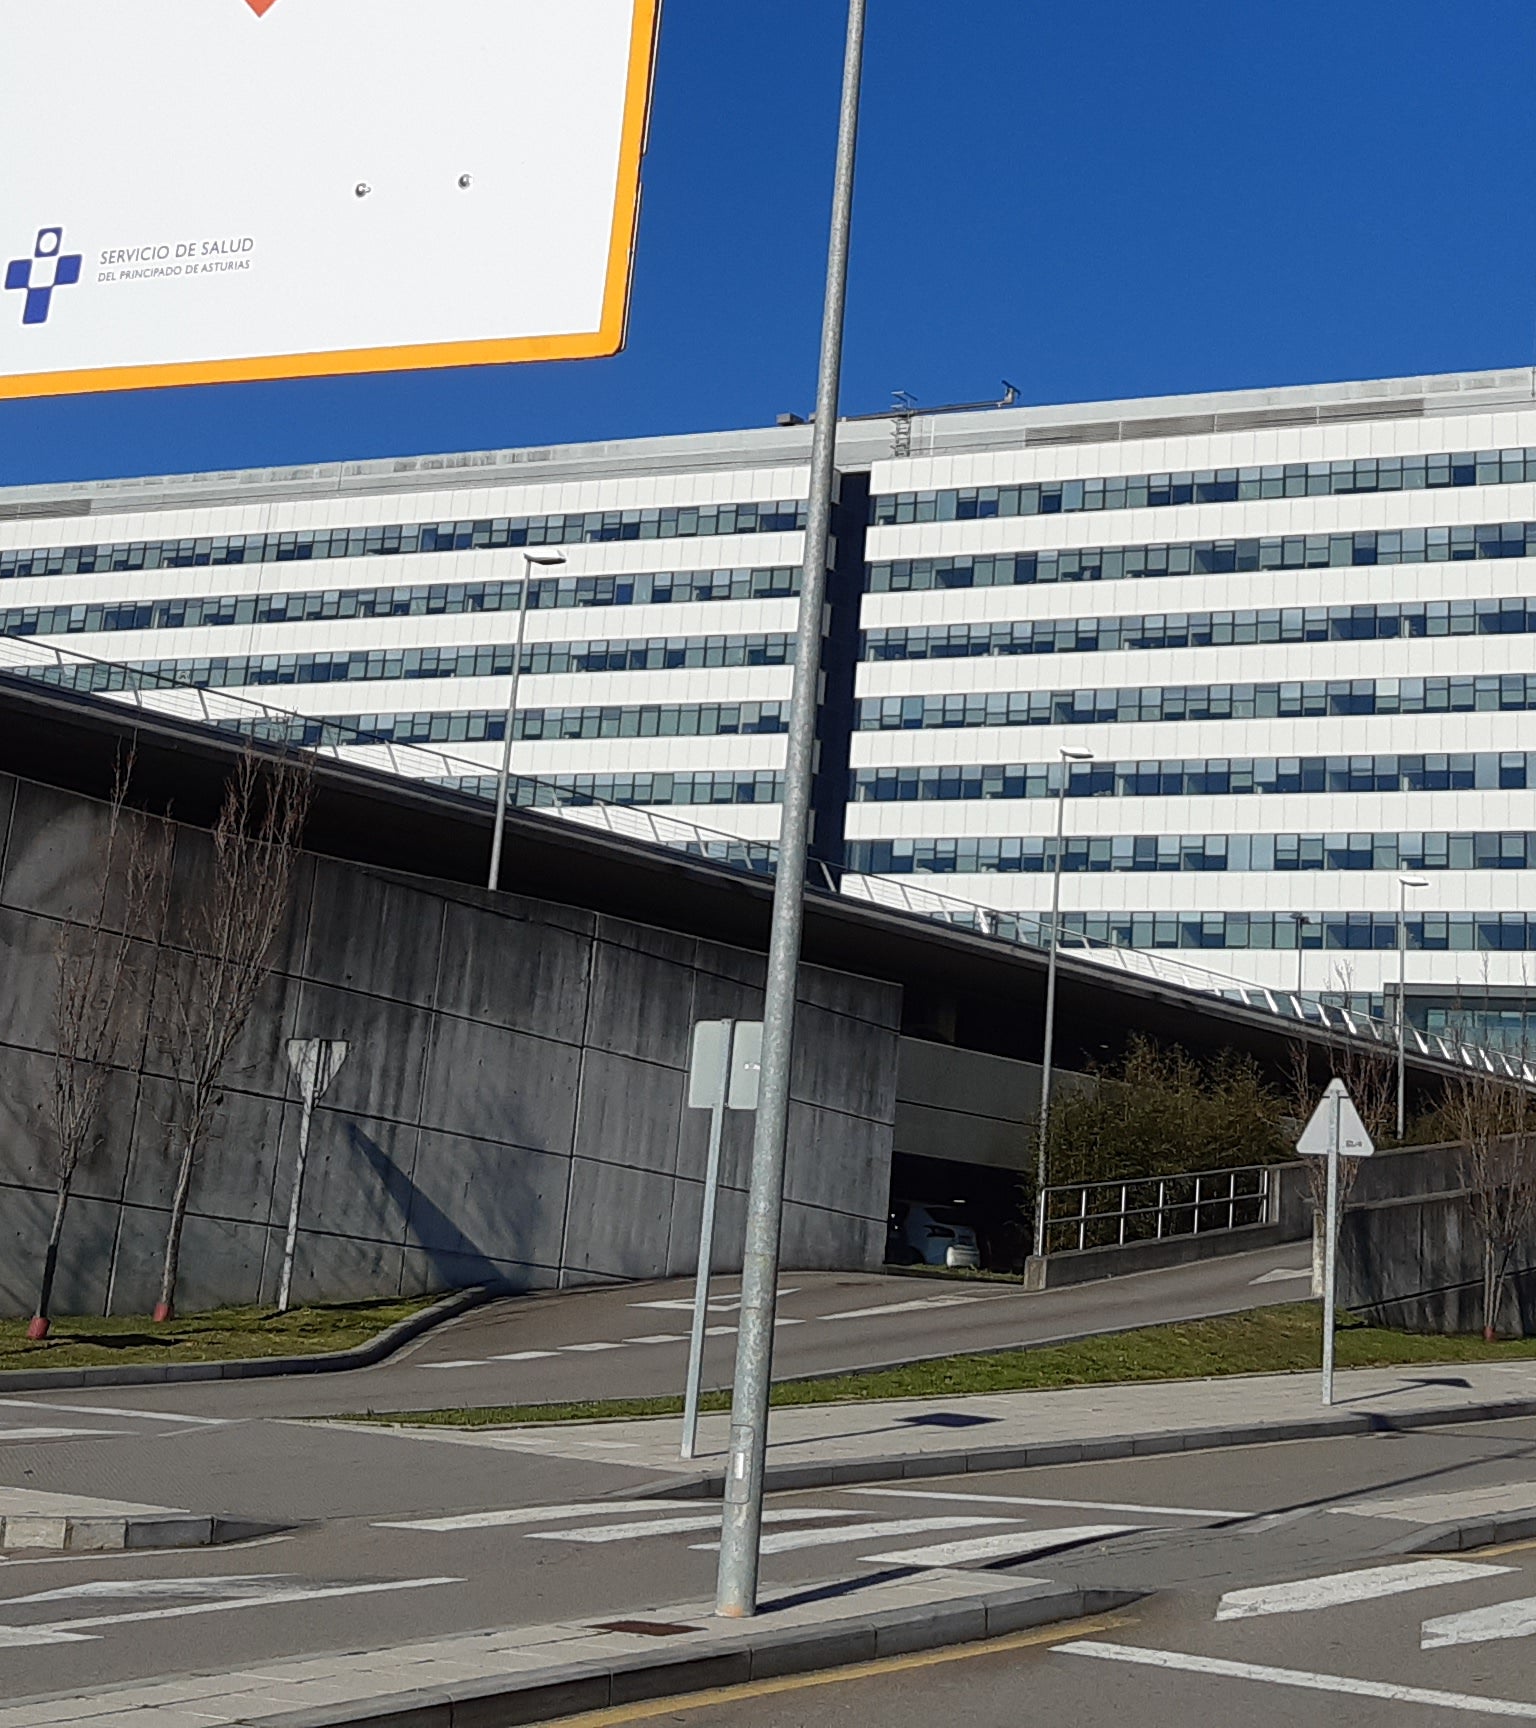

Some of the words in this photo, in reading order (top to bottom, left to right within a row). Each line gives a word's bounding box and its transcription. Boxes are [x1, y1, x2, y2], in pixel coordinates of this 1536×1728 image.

[99, 245, 170, 265] SERVICIO
[175, 242, 197, 258] DE
[200, 237, 254, 256] SALUD
[97, 271, 117, 282] DEL
[119, 265, 183, 280] PRINCIPADO
[184, 263, 200, 274] DE
[200, 259, 251, 273] ASTURIAS
